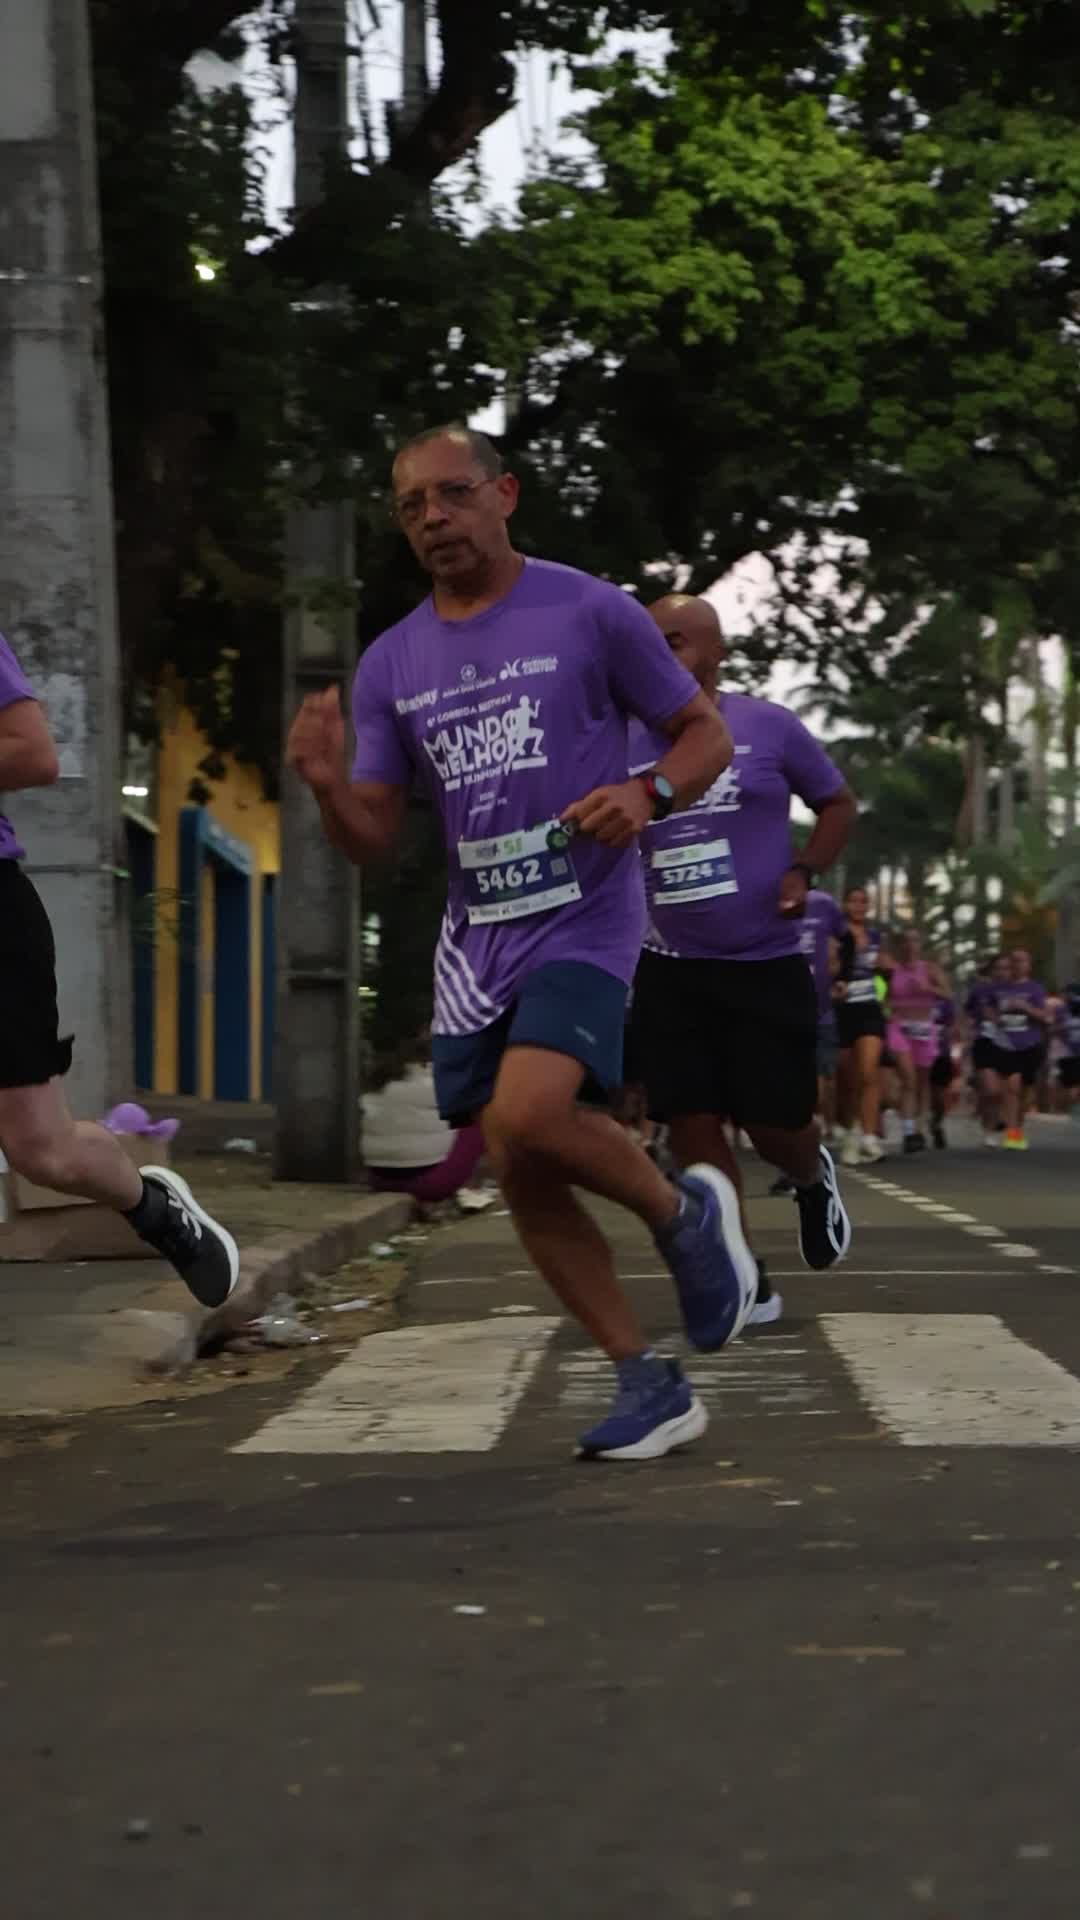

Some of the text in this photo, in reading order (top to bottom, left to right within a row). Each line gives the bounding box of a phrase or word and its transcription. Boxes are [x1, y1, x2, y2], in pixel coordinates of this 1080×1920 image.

[422, 708, 518, 756] MUNDO
[475, 858, 544, 895] 5462
[662, 862, 714, 886] 5724
